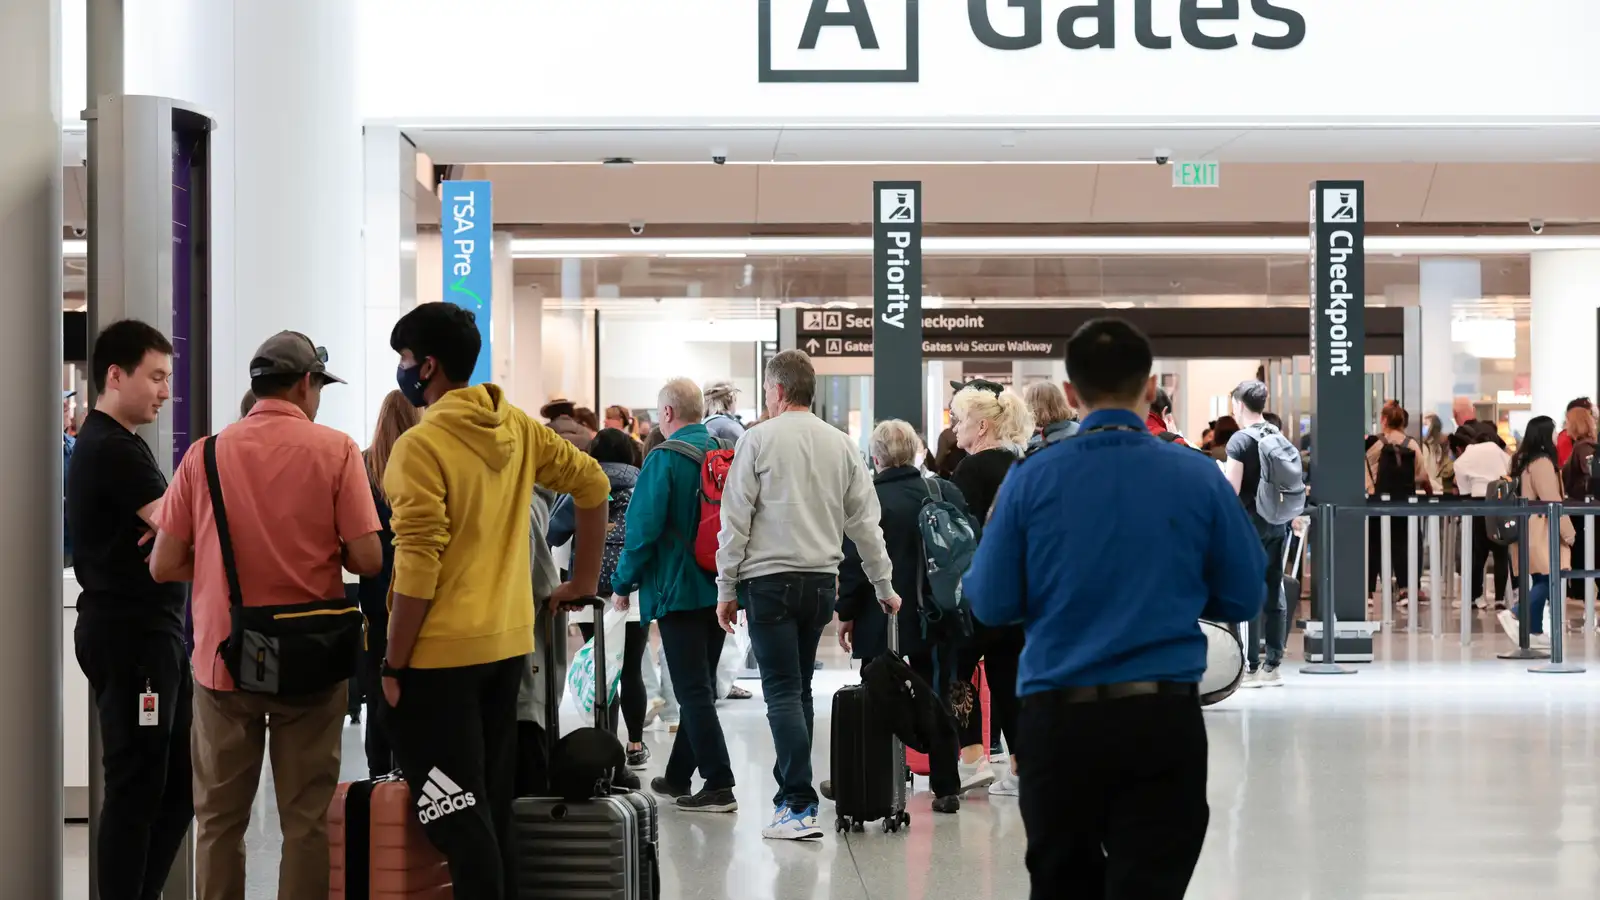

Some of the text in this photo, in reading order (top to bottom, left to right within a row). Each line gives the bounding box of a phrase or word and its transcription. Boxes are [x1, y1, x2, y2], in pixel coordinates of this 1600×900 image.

[797, 0, 1306, 51] A Gates
[1181, 163, 1217, 185] EXIT
[453, 191, 475, 276] TSA Pre
[881, 231, 911, 329] Priority
[921, 314, 985, 331] eckpoint
[1324, 230, 1354, 376] Checkpoint
[921, 340, 953, 352] Gates
[954, 341, 970, 352] via
[970, 340, 1006, 352] Secure
[1006, 340, 1053, 354] Walkway
[418, 792, 476, 824] adidas
